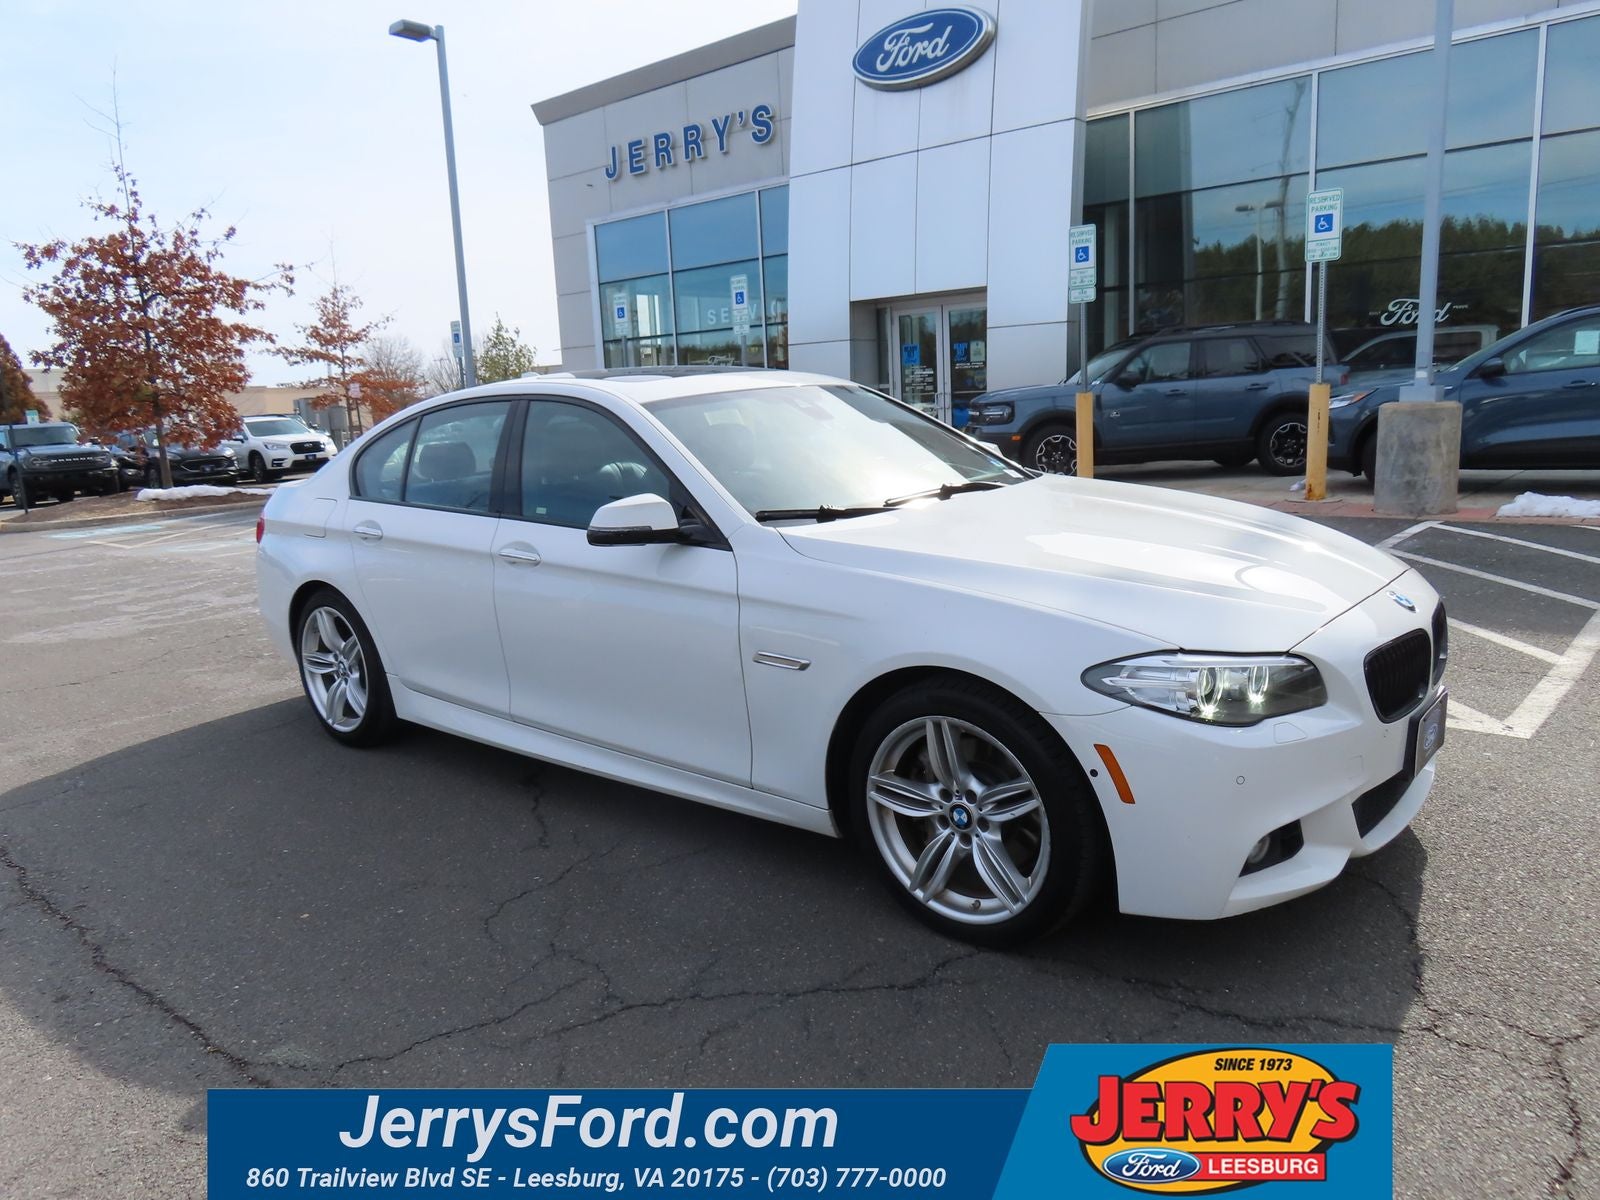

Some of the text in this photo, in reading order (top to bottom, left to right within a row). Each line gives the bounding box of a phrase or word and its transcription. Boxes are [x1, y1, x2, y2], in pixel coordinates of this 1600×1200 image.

[876, 22, 953, 72] Ford
[604, 103, 774, 181] JERRY'S
[1311, 205, 1338, 213] PARKING
[1380, 298, 1452, 326] Fod
